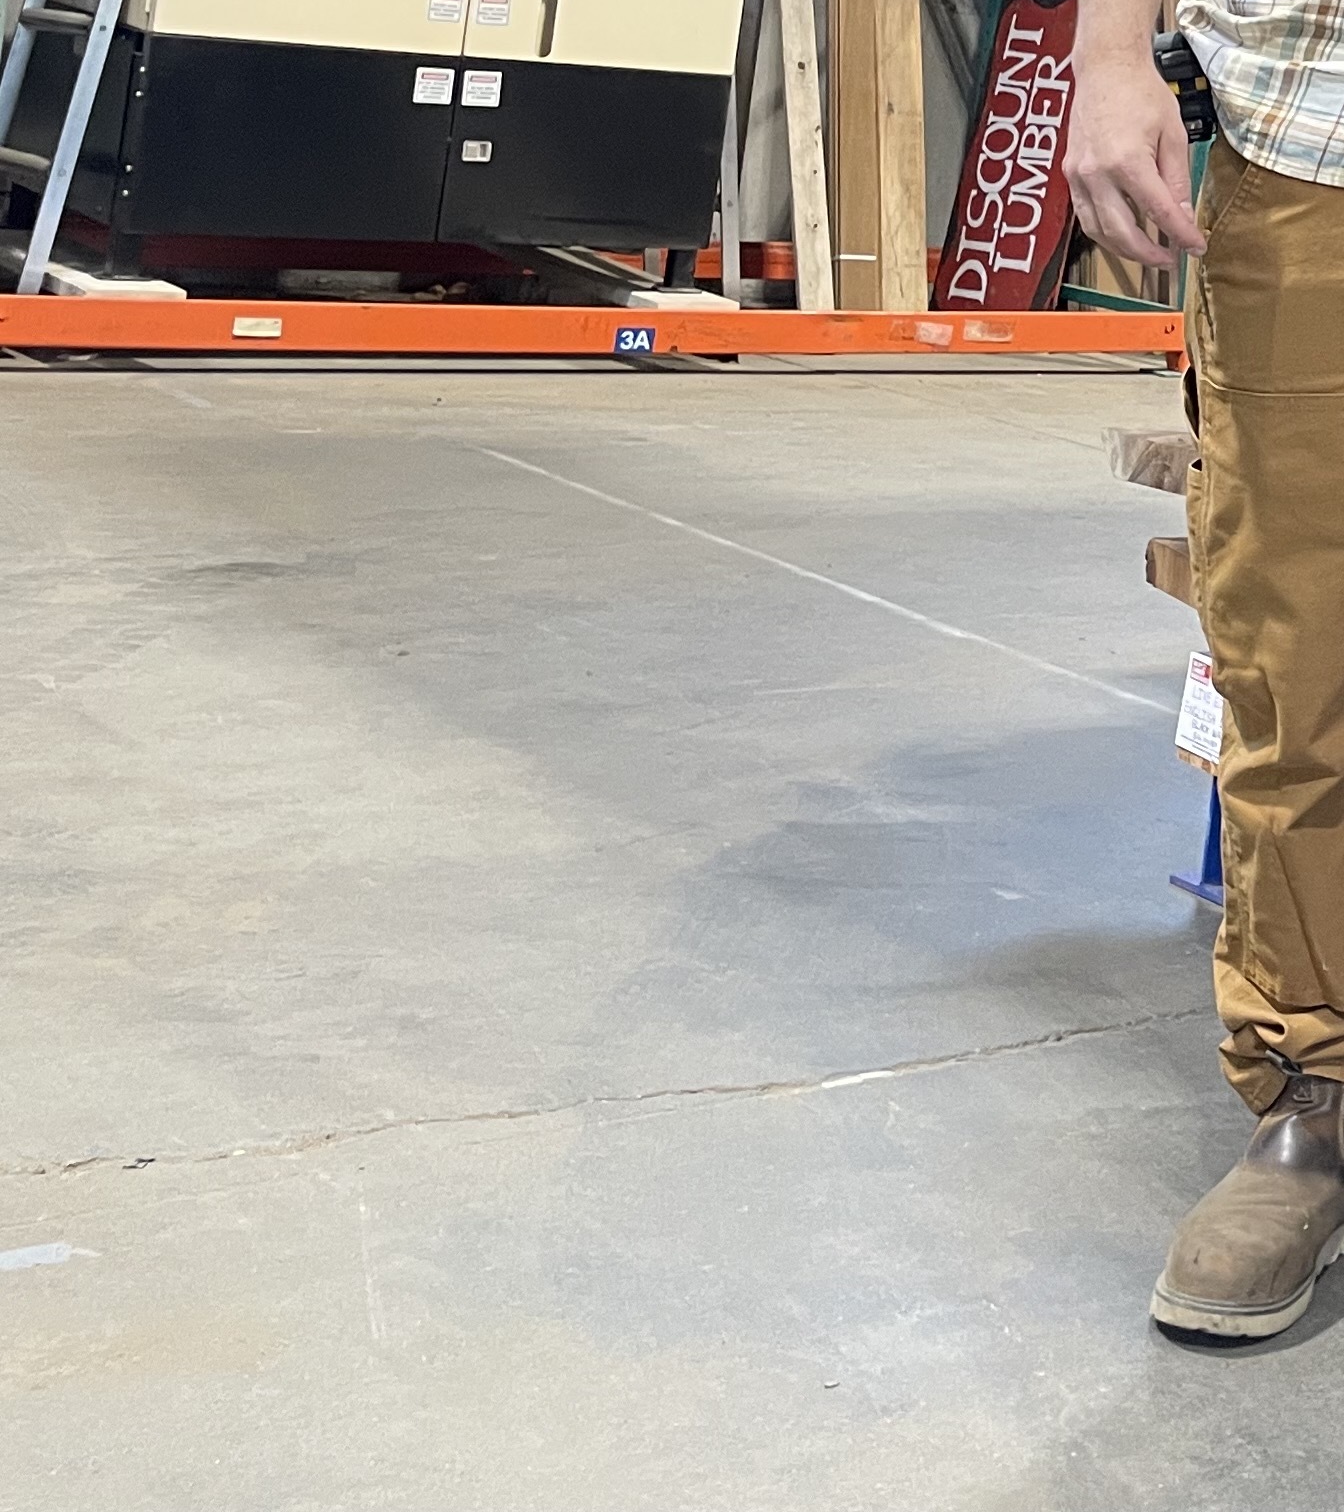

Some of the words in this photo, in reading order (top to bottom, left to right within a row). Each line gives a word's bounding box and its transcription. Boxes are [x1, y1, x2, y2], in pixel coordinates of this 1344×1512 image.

[947, 13, 1045, 305] DISCOUNT
[992, 54, 1074, 275] LUMBER
[619, 330, 650, 350] 3A
